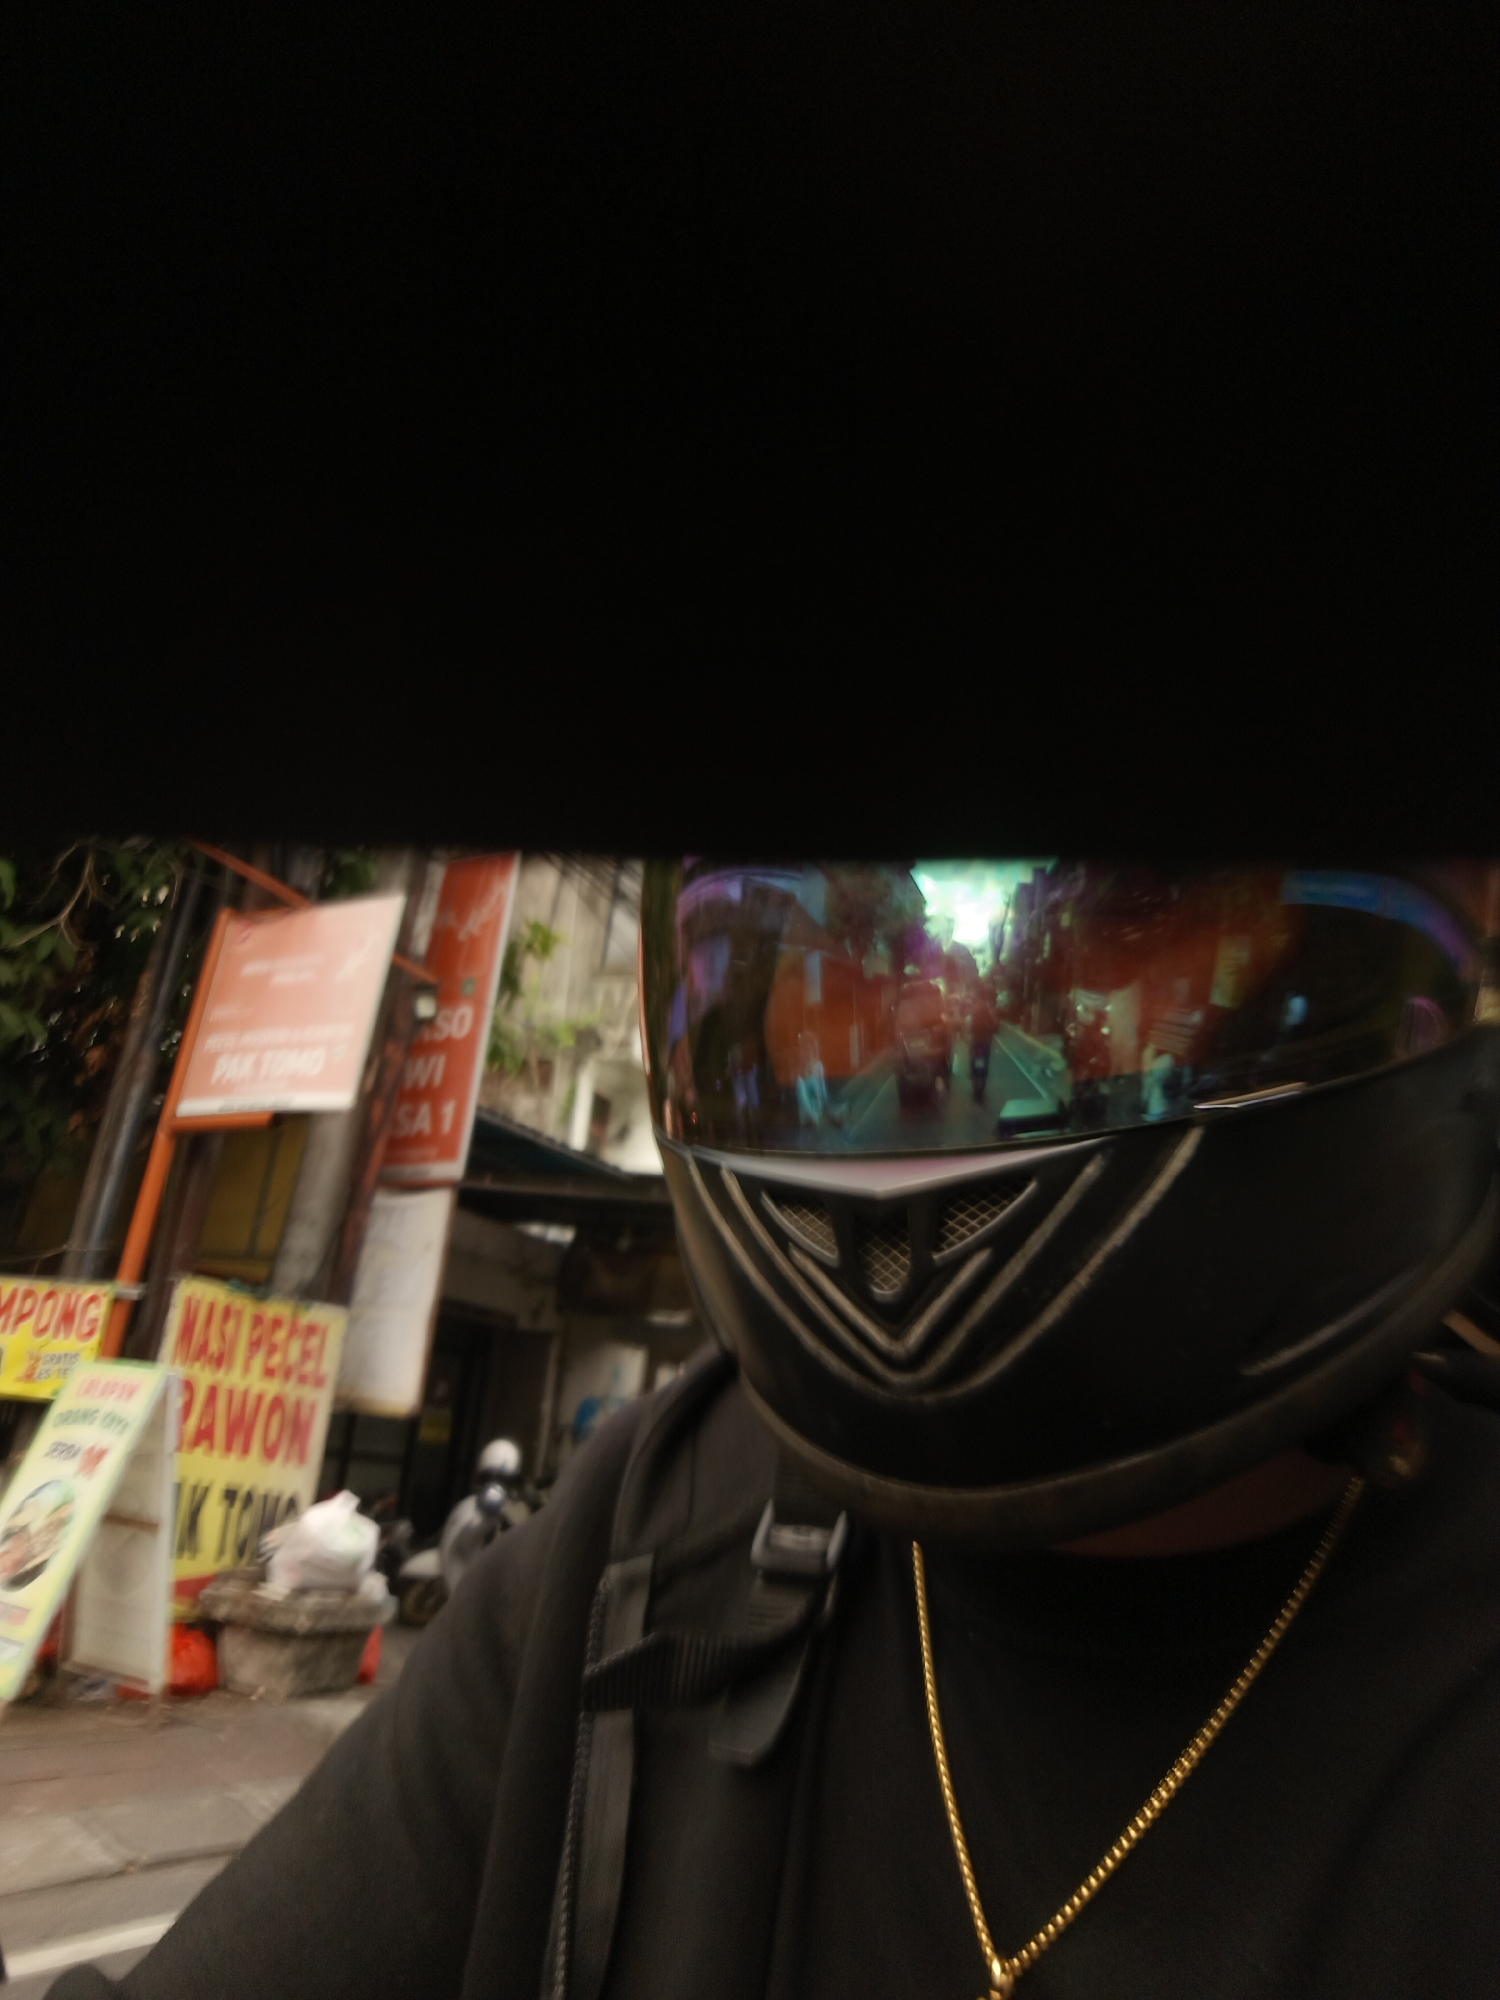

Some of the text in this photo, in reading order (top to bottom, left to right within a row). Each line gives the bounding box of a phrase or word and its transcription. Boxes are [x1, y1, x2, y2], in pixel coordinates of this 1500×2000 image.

[422, 1005, 474, 1041] SO
[211, 1053, 257, 1085] PAK
[169, 1295, 329, 1390] NASI PECEL
[36, 1367, 51, 1381] ES
[52, 1408, 100, 1429] ORANG
[175, 1378, 319, 1467] RAWON
